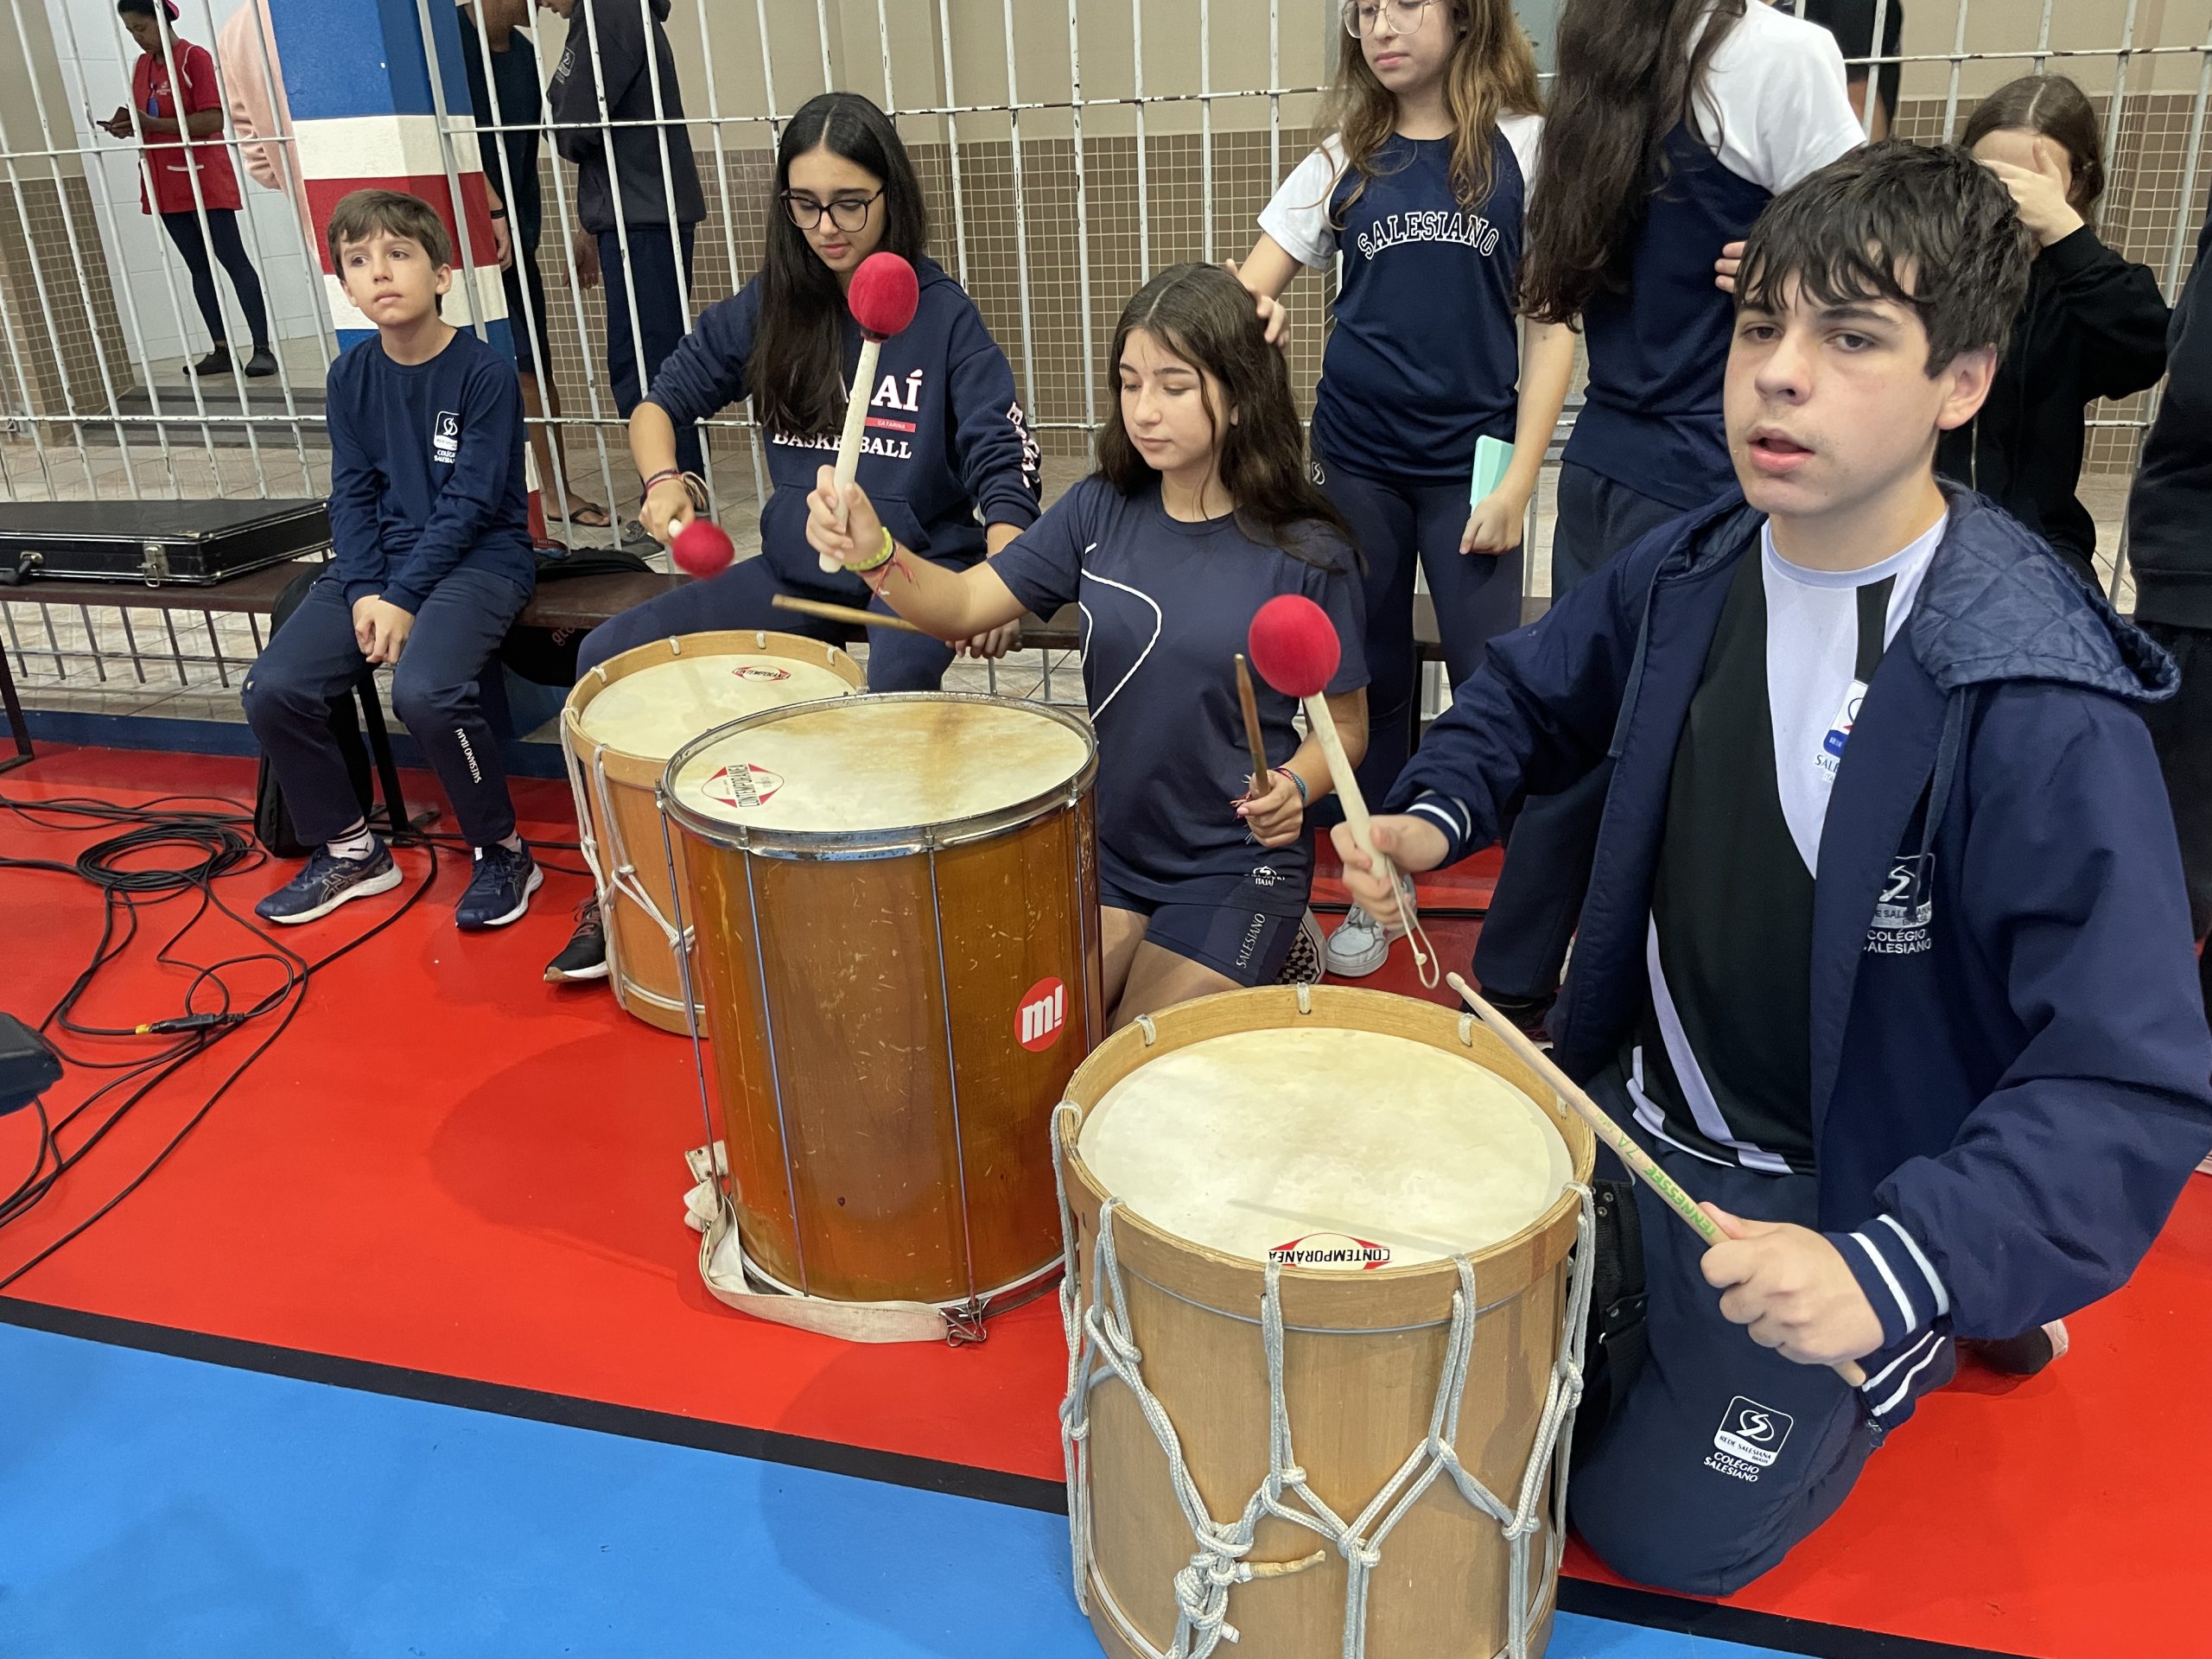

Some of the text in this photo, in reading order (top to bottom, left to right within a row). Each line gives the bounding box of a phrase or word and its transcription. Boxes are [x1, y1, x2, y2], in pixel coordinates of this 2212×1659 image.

[1357, 212, 1499, 259] SALESIANO
[877, 418, 906, 430] CATARINA
[772, 430, 912, 460] BASKEBALL
[1236, 913, 1266, 969] SALESIANO
[1864, 938, 1931, 954] ALESIANO
[1866, 928, 1926, 942] COLÉGIO
[1021, 984, 1064, 1044] m!
[1618, 1132, 1639, 1160] 7A
[1643, 1164, 1716, 1237] TENNESSEE
[1719, 1435, 1771, 1459] REDE SALESIANA
[1703, 1456, 1758, 1482] SALESIANO
[1713, 1452, 1760, 1474] COLÉGIO
